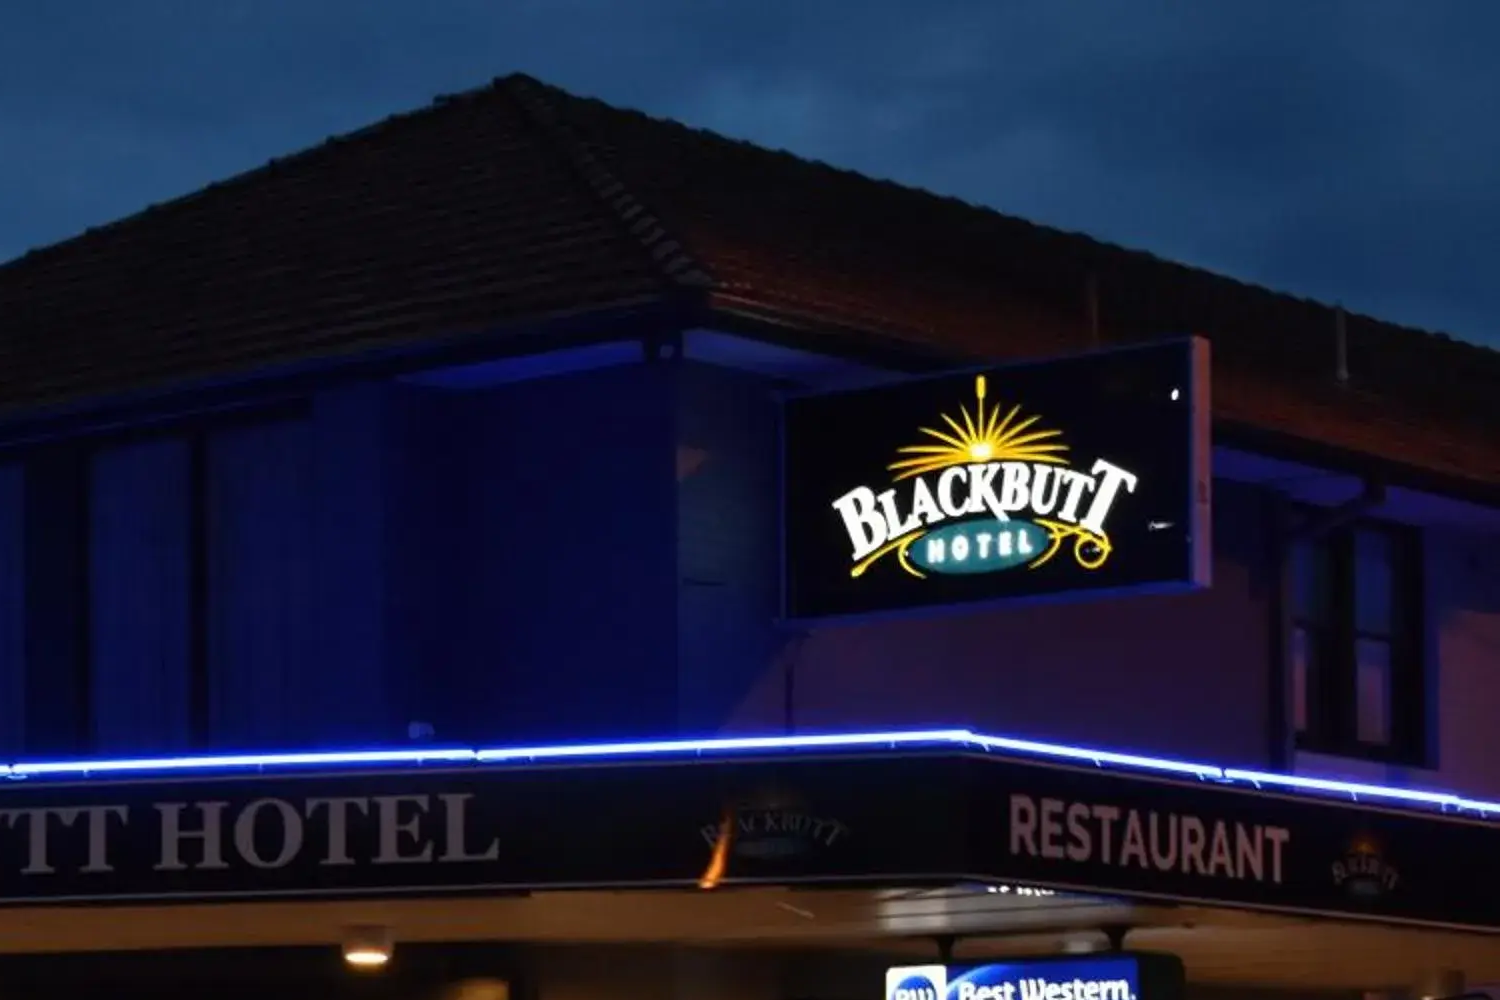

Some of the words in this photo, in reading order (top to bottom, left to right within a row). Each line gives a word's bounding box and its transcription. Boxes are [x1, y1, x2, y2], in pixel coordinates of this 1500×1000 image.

[832, 458, 1137, 561] BLACKBUTT
[926, 529, 1033, 563] HOTEL
[152, 792, 501, 871] HOTEL
[1008, 794, 1290, 884] RESTAURANT
